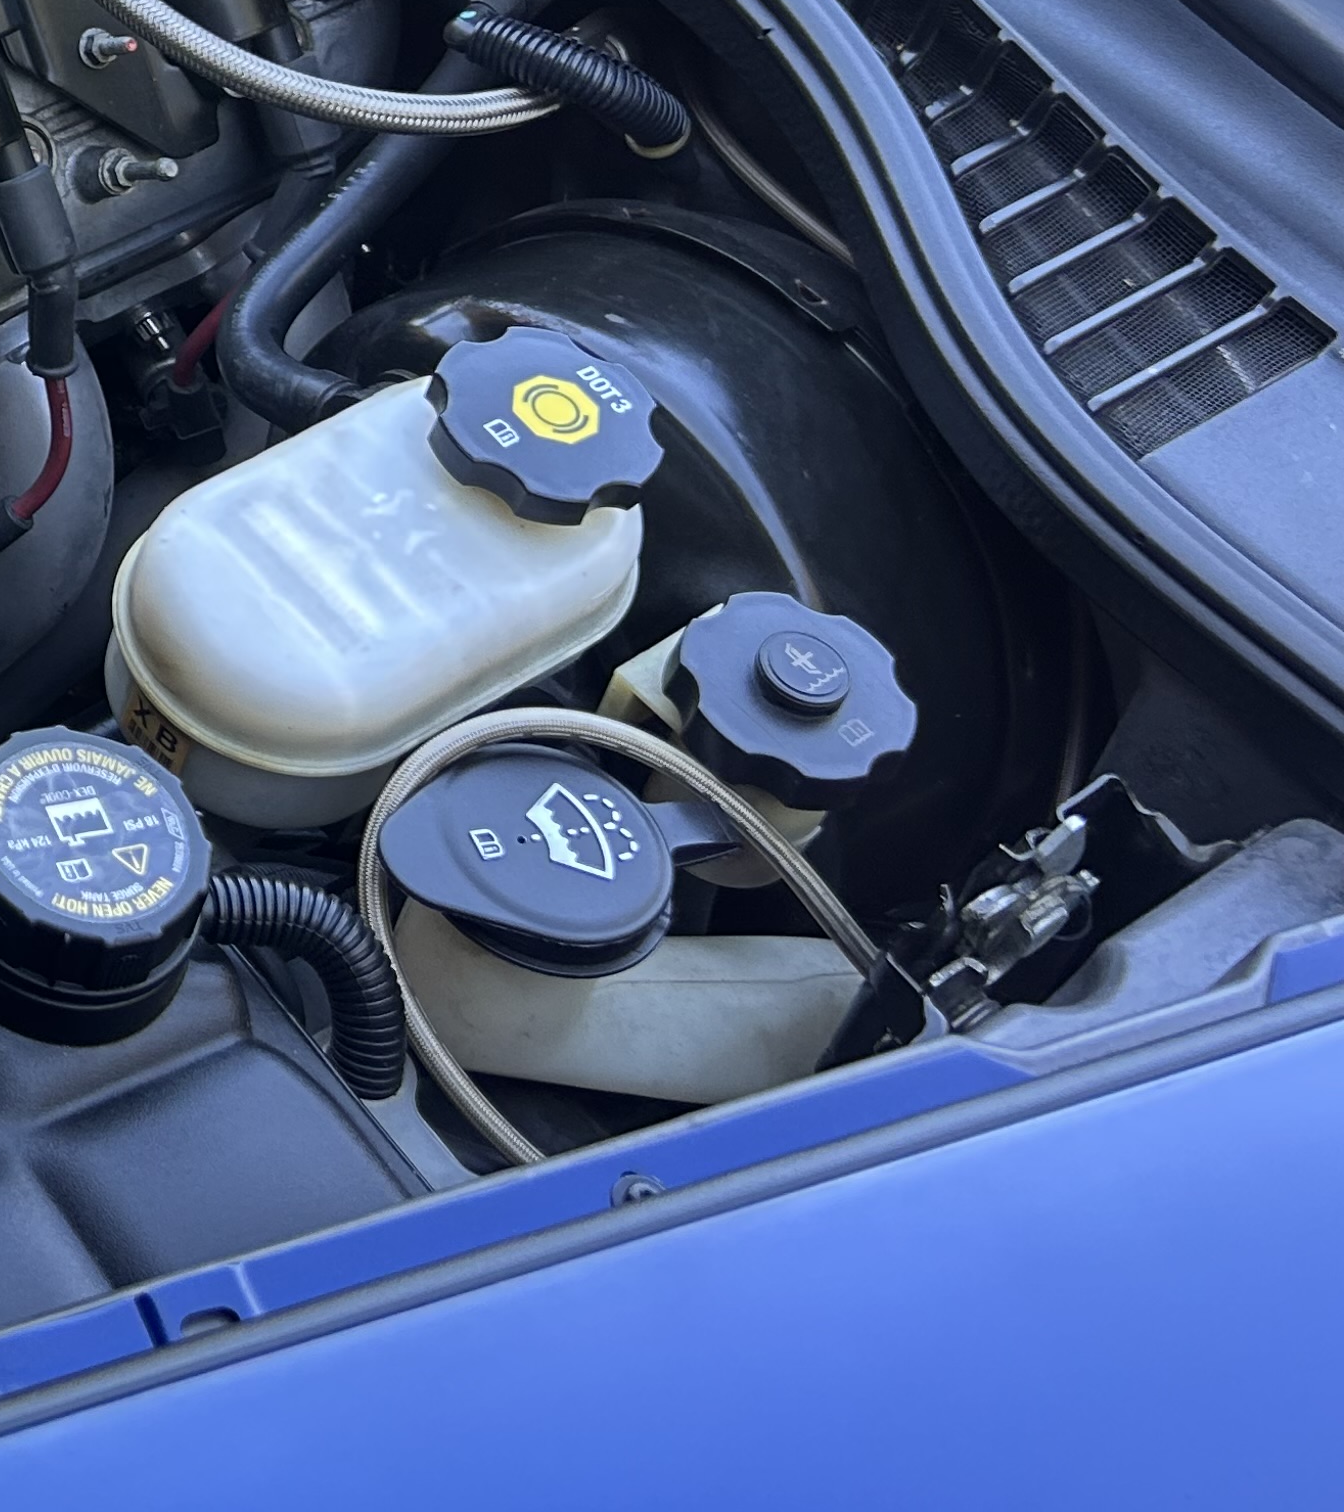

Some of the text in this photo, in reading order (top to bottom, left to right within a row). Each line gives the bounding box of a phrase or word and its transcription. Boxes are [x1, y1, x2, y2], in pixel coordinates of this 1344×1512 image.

[576, 364, 633, 415] DOT 3
[18, 747, 72, 768] OUVRIR
[76, 748, 135, 778] JAMAIS
[133, 775, 157, 796] NE
[123, 817, 144, 831] PSI
[145, 814, 159, 828] 18
[7, 834, 51, 850] 124 kPa
[52, 876, 173, 918] NEVER OPEN HOT!
[81, 882, 143, 902] SURGE TANK
